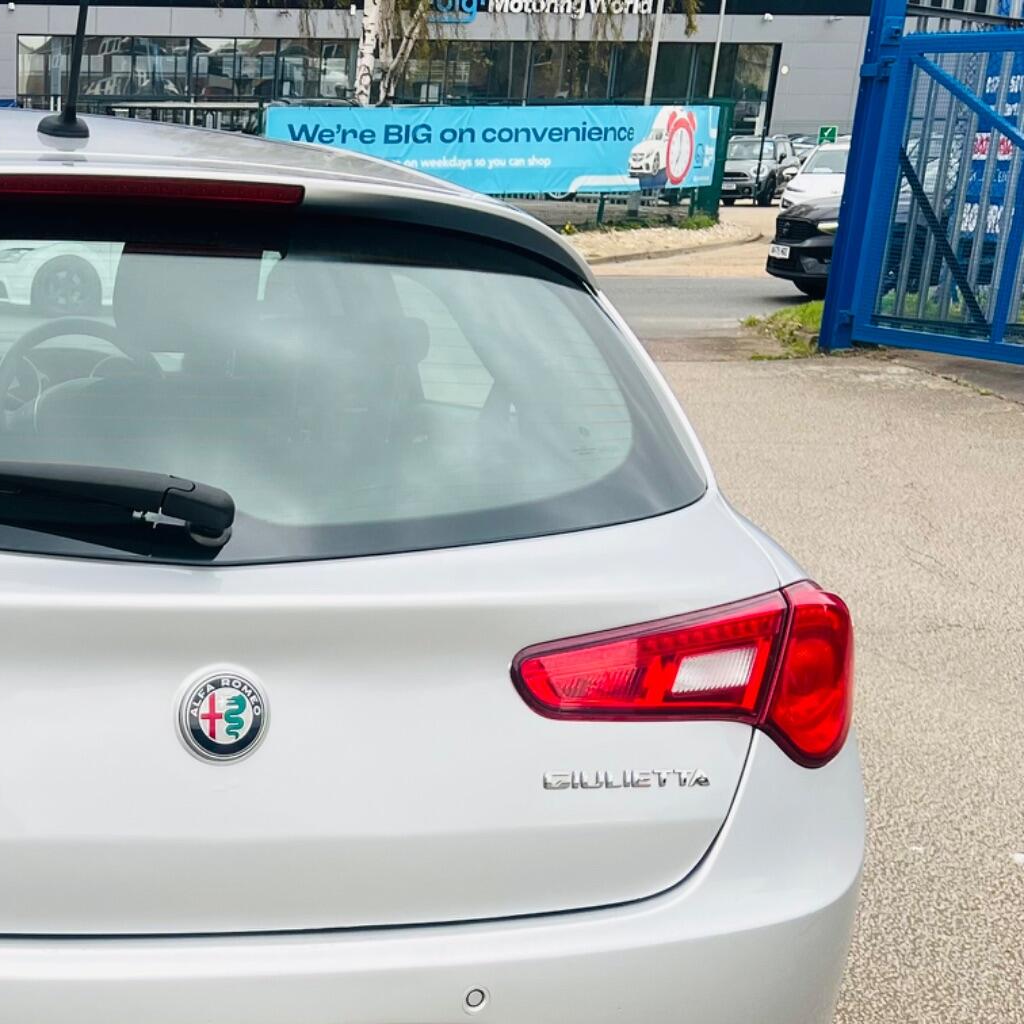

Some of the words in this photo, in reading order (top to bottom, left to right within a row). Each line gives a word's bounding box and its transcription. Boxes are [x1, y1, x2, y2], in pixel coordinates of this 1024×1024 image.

[488, 0, 585, 18] Motoring
[589, 0, 653, 14] World
[288, 123, 376, 144] We're
[384, 124, 432, 144] BIG
[440, 127, 475, 143] on
[482, 121, 635, 143] convenience
[421, 155, 471, 170] weekdays
[475, 158, 485, 168] so
[488, 157, 507, 170] you
[509, 156, 525, 167] can
[528, 154, 552, 169] shop
[190, 684, 216, 718] ALFA
[221, 678, 261, 716] ROMEO
[542, 768, 711, 790] GIULIETTA
